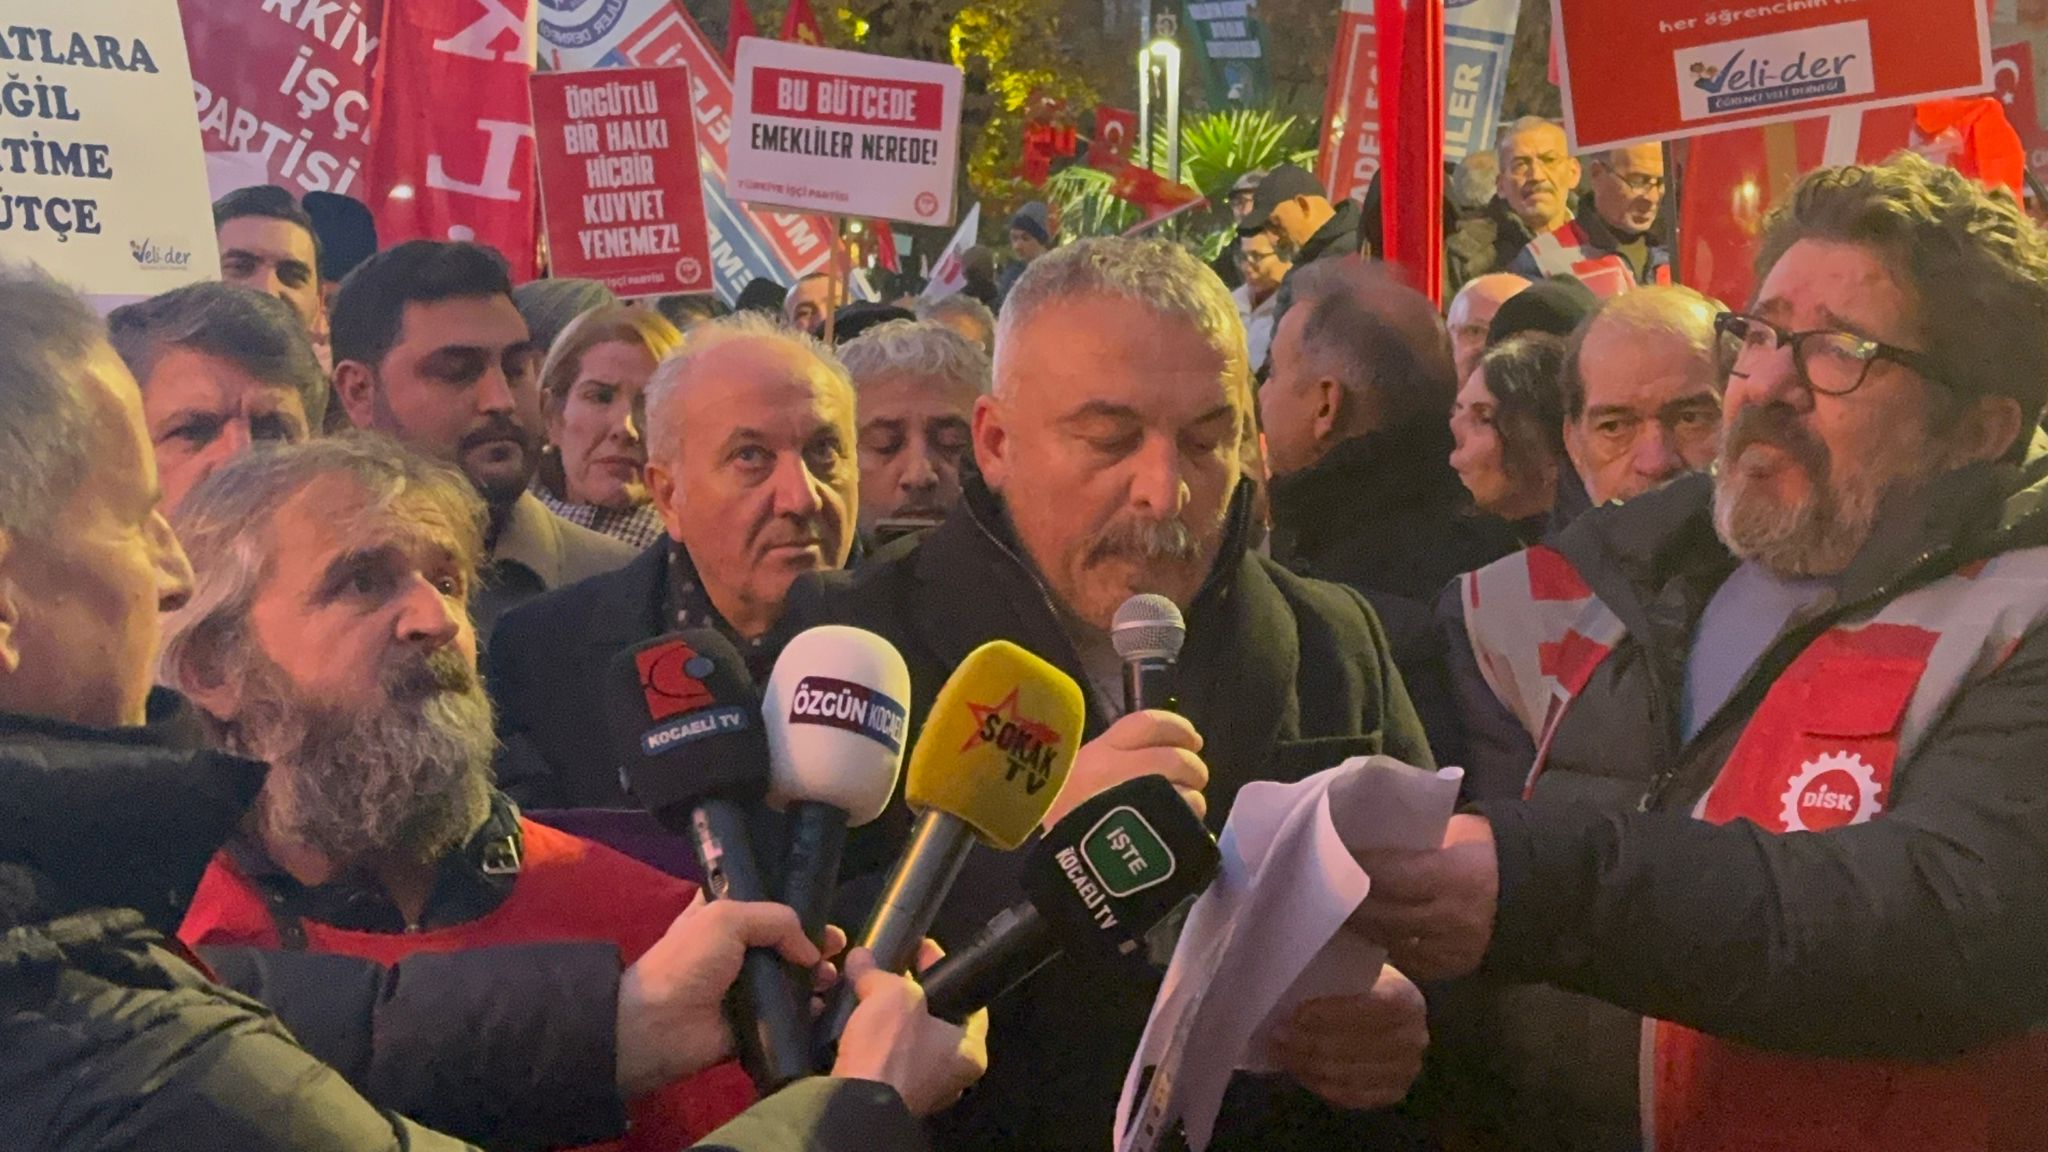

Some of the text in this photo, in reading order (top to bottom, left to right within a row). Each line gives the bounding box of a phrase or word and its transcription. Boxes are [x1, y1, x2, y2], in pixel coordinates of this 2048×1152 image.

[261, 0, 379, 78] RKİY
[1659, 17, 1698, 33] her
[0, 72, 80, 121] ĞİL
[564, 81, 659, 119] ÖRGÜTLÜ
[777, 76, 809, 112] BU
[817, 79, 918, 122] BÜTÇEDE
[0, 131, 113, 180] TİME
[563, 119, 669, 155] BİR HALKI
[751, 122, 938, 166] EMEKLİLER NEREDE!
[586, 152, 655, 189] HİÇBİR
[582, 189, 664, 225] KUVVET
[578, 224, 681, 261] YENEMEZ!
[718, 713, 740, 728] TV
[793, 683, 868, 725] ÖZGÜN
[980, 713, 1058, 780] SOKAK
[1006, 756, 1046, 795] TV
[1802, 784, 1854, 811] DİSK
[1094, 904, 1119, 930] TV
